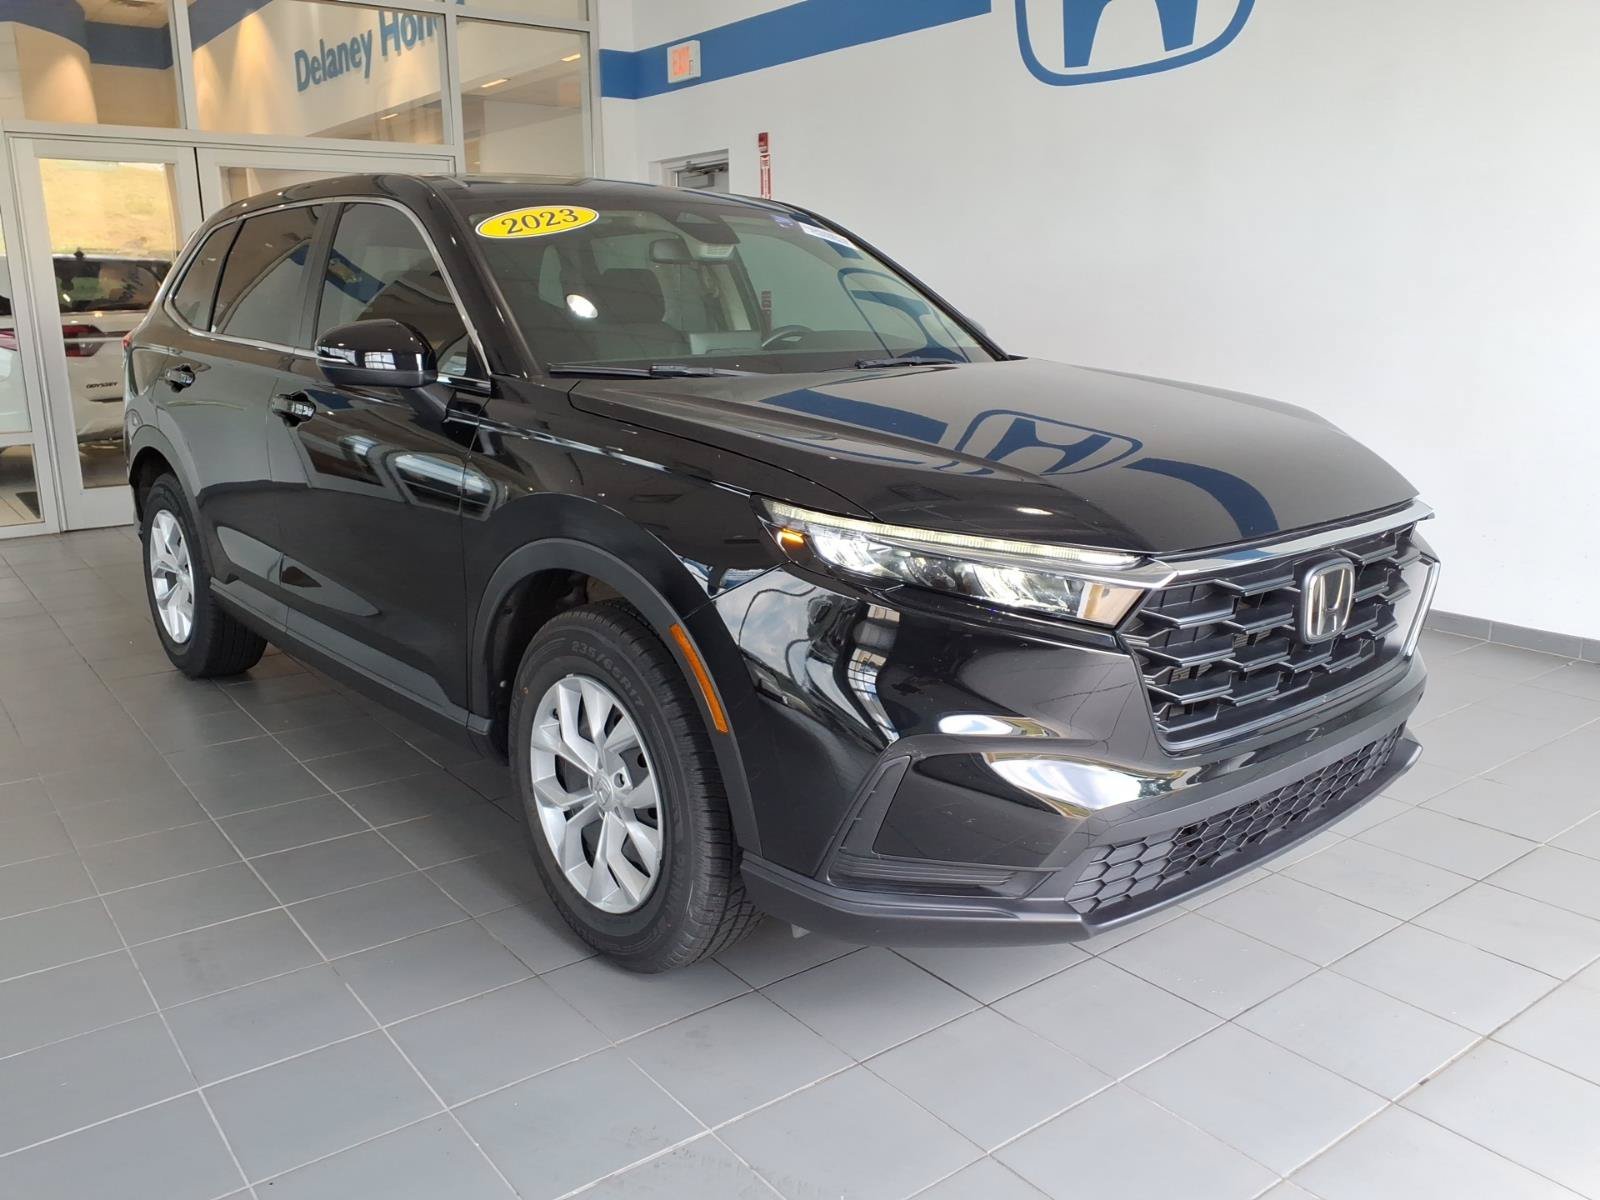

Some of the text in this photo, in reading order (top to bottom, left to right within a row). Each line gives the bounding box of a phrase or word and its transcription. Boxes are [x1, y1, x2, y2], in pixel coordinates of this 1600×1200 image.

[294, 9, 438, 92] Delaney Hon
[501, 208, 579, 235] 2023
